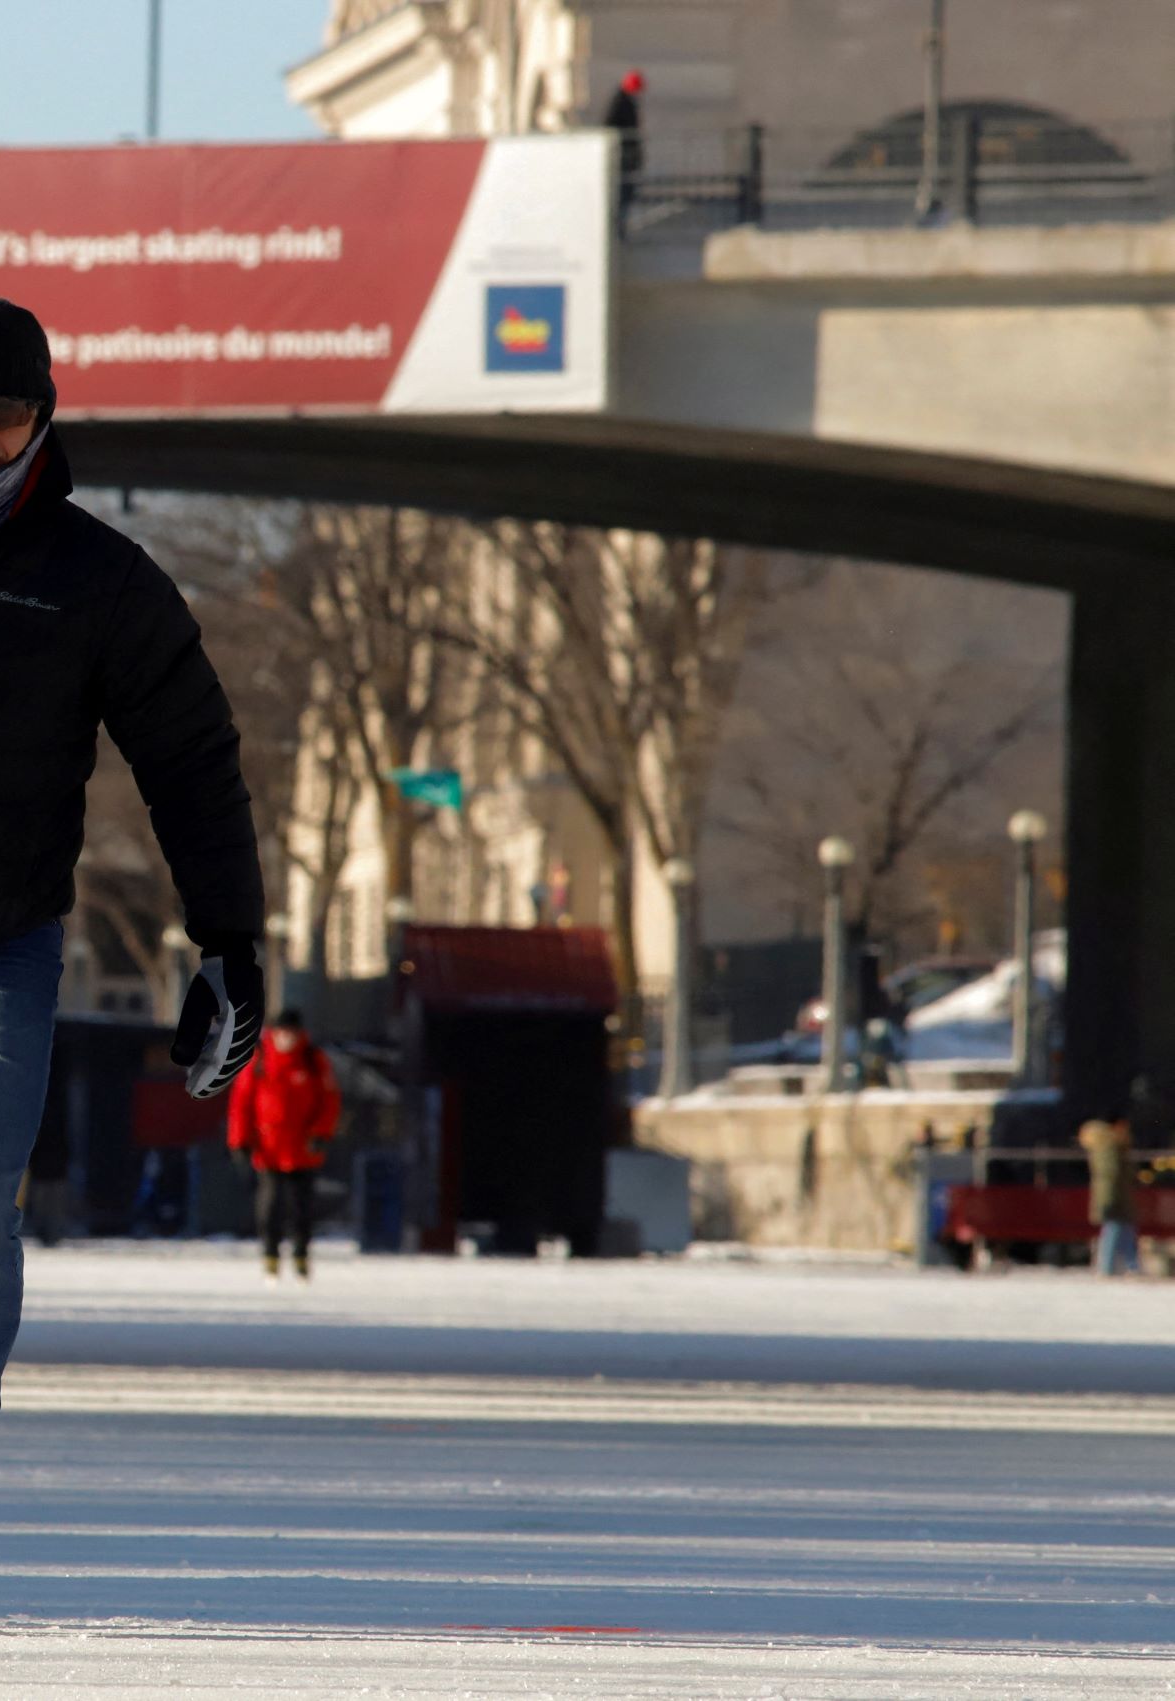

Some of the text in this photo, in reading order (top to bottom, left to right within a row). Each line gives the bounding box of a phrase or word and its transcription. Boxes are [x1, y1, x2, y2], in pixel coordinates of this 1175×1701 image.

[29, 230, 140, 271] largest
[146, 227, 261, 269] skating
[265, 225, 342, 262] rink!
[77, 326, 217, 369] patinoire
[222, 326, 265, 361] du
[268, 323, 392, 360] monde!
